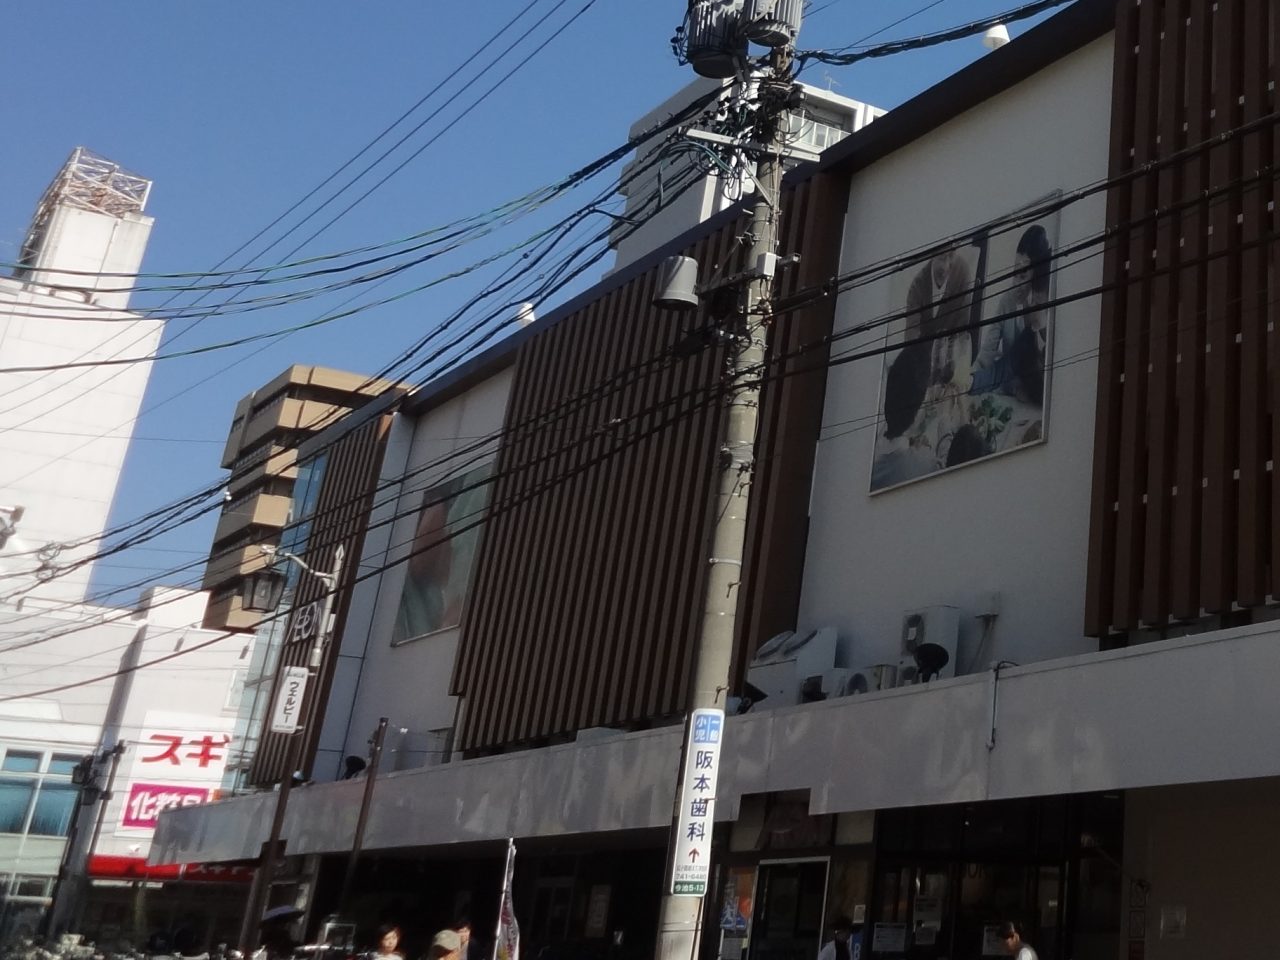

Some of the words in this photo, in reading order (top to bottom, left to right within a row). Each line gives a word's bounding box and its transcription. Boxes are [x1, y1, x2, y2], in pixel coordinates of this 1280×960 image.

[142, 734, 231, 767] スギ
[687, 750, 714, 842] 阪本歯科
